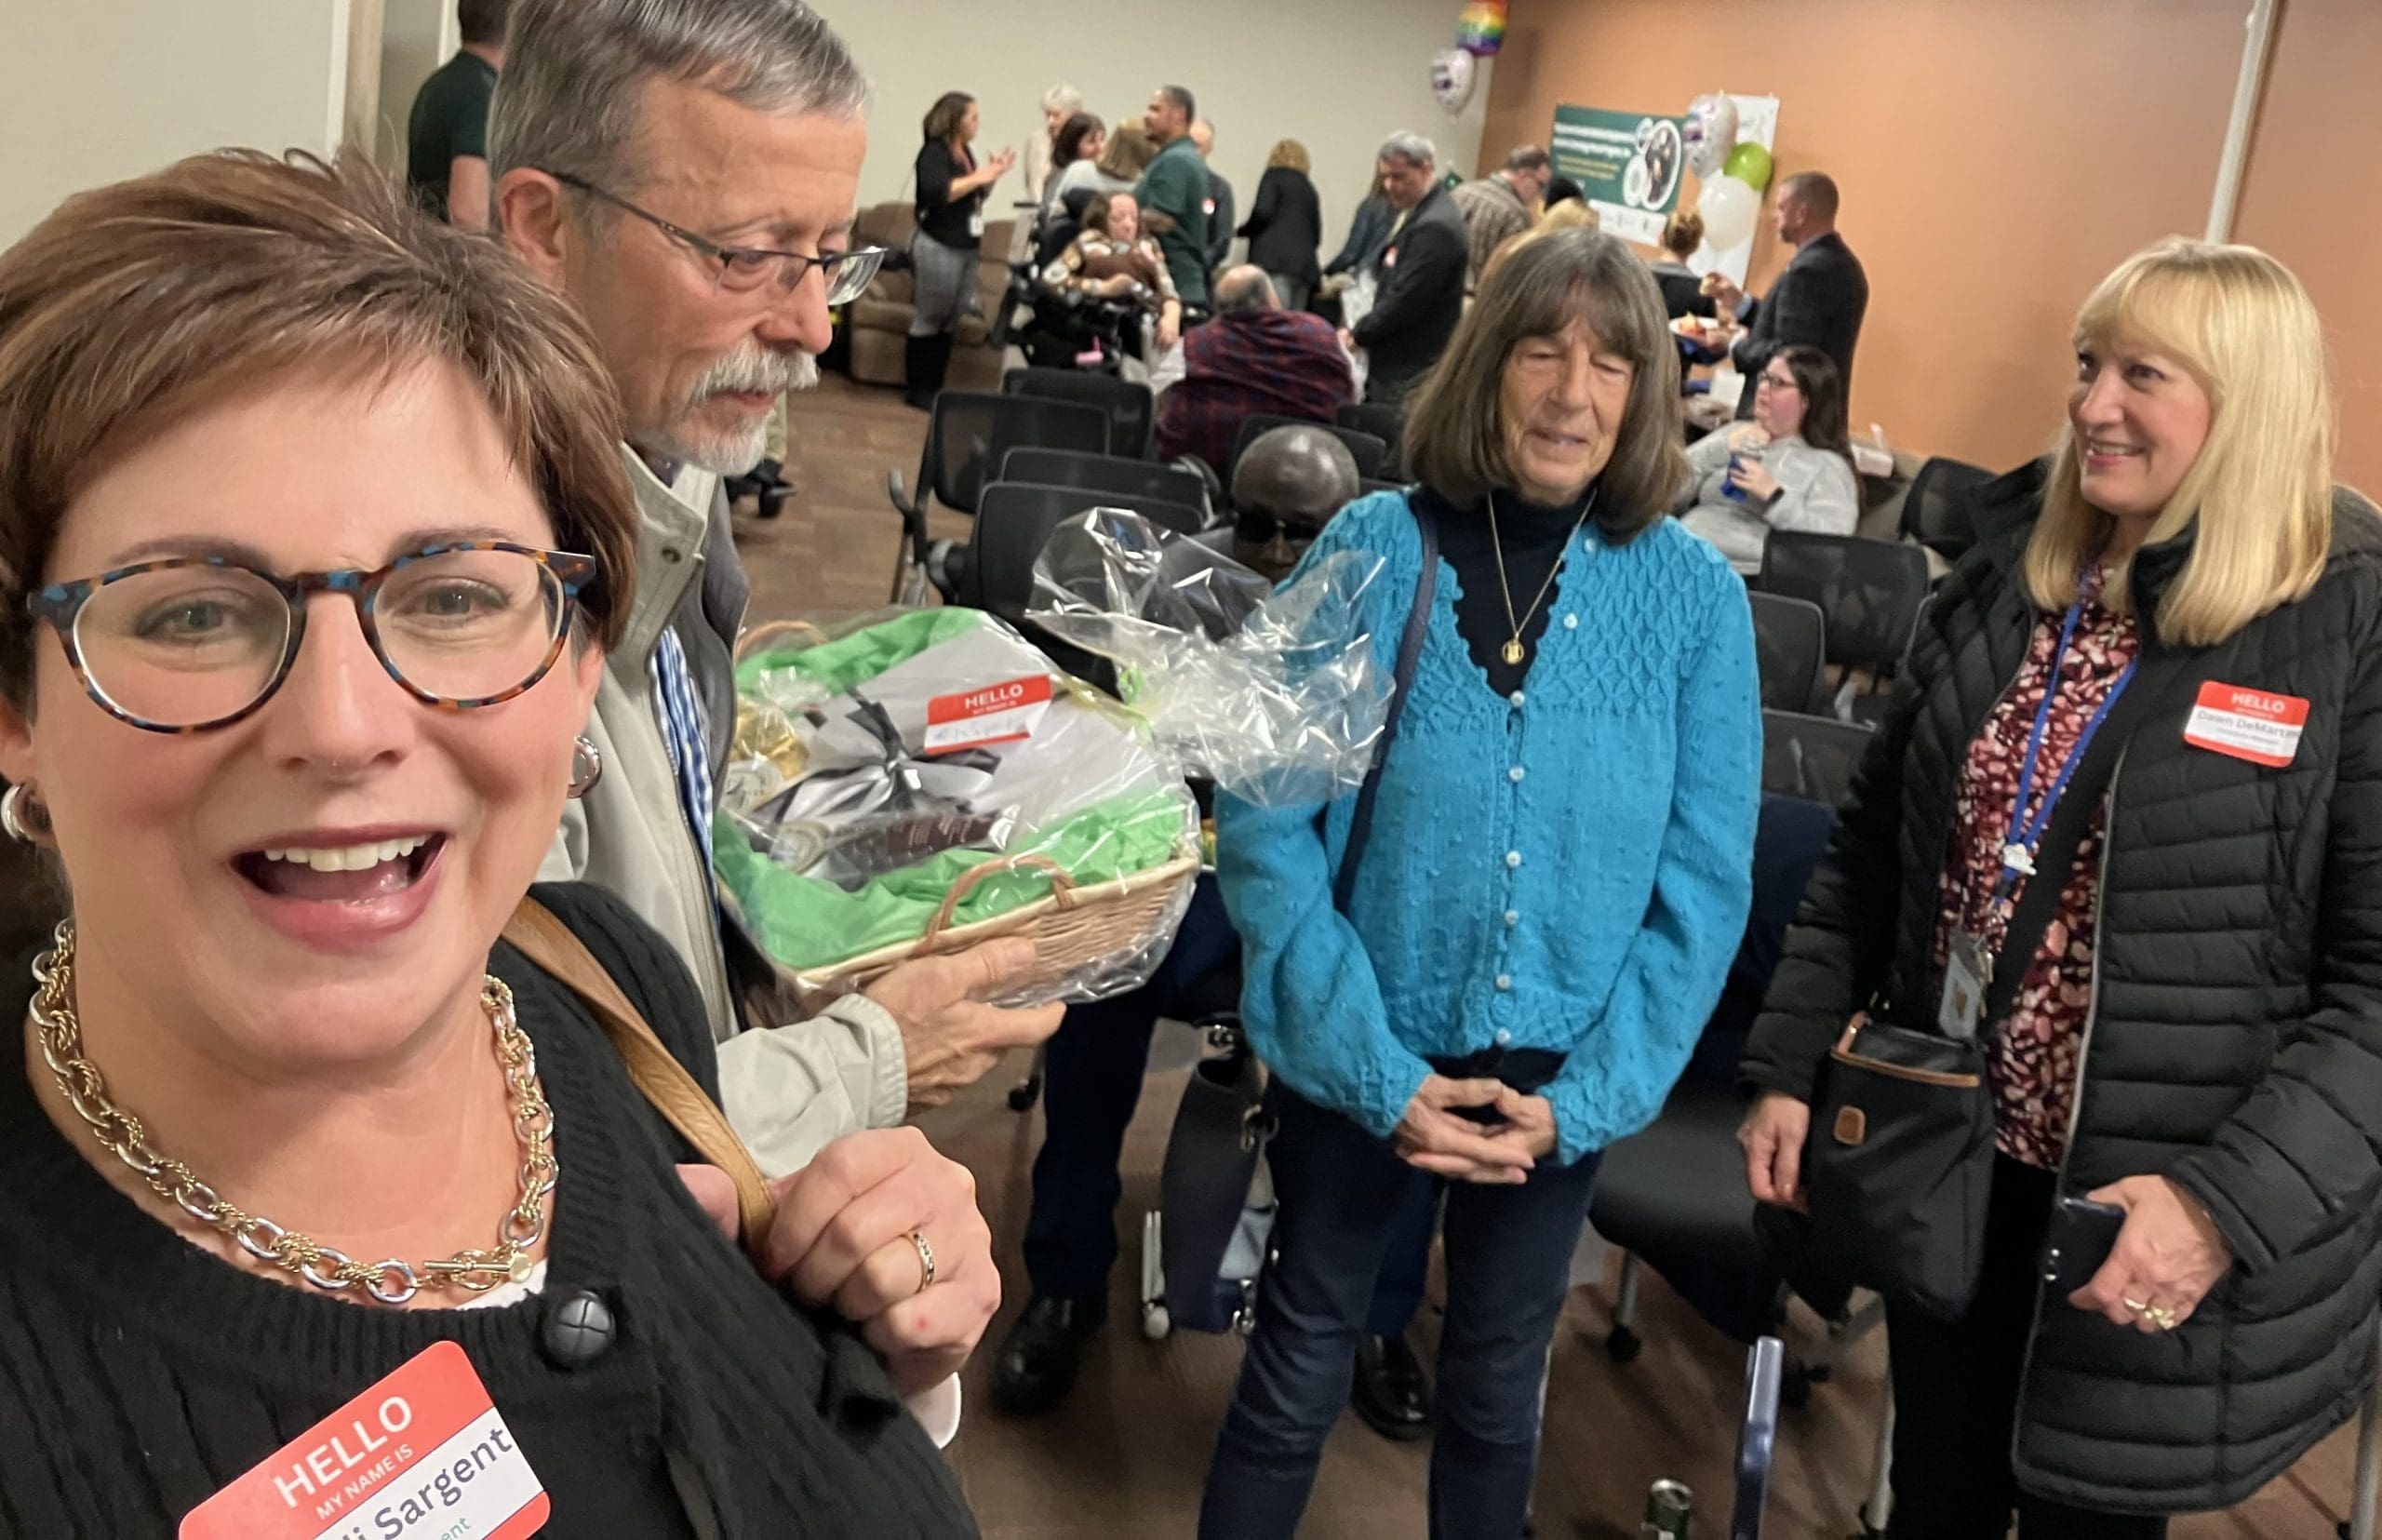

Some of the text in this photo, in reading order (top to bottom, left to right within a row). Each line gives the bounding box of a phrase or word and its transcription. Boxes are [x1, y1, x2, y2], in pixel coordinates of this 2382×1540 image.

[964, 684, 1024, 710] HELLO
[2231, 692, 2285, 714] HELLO
[273, 1396, 412, 1508] HELLO
[315, 1444, 413, 1520] MY NAME IS
[374, 1428, 513, 1540] Sargent
[441, 1518, 471, 1540] ent
